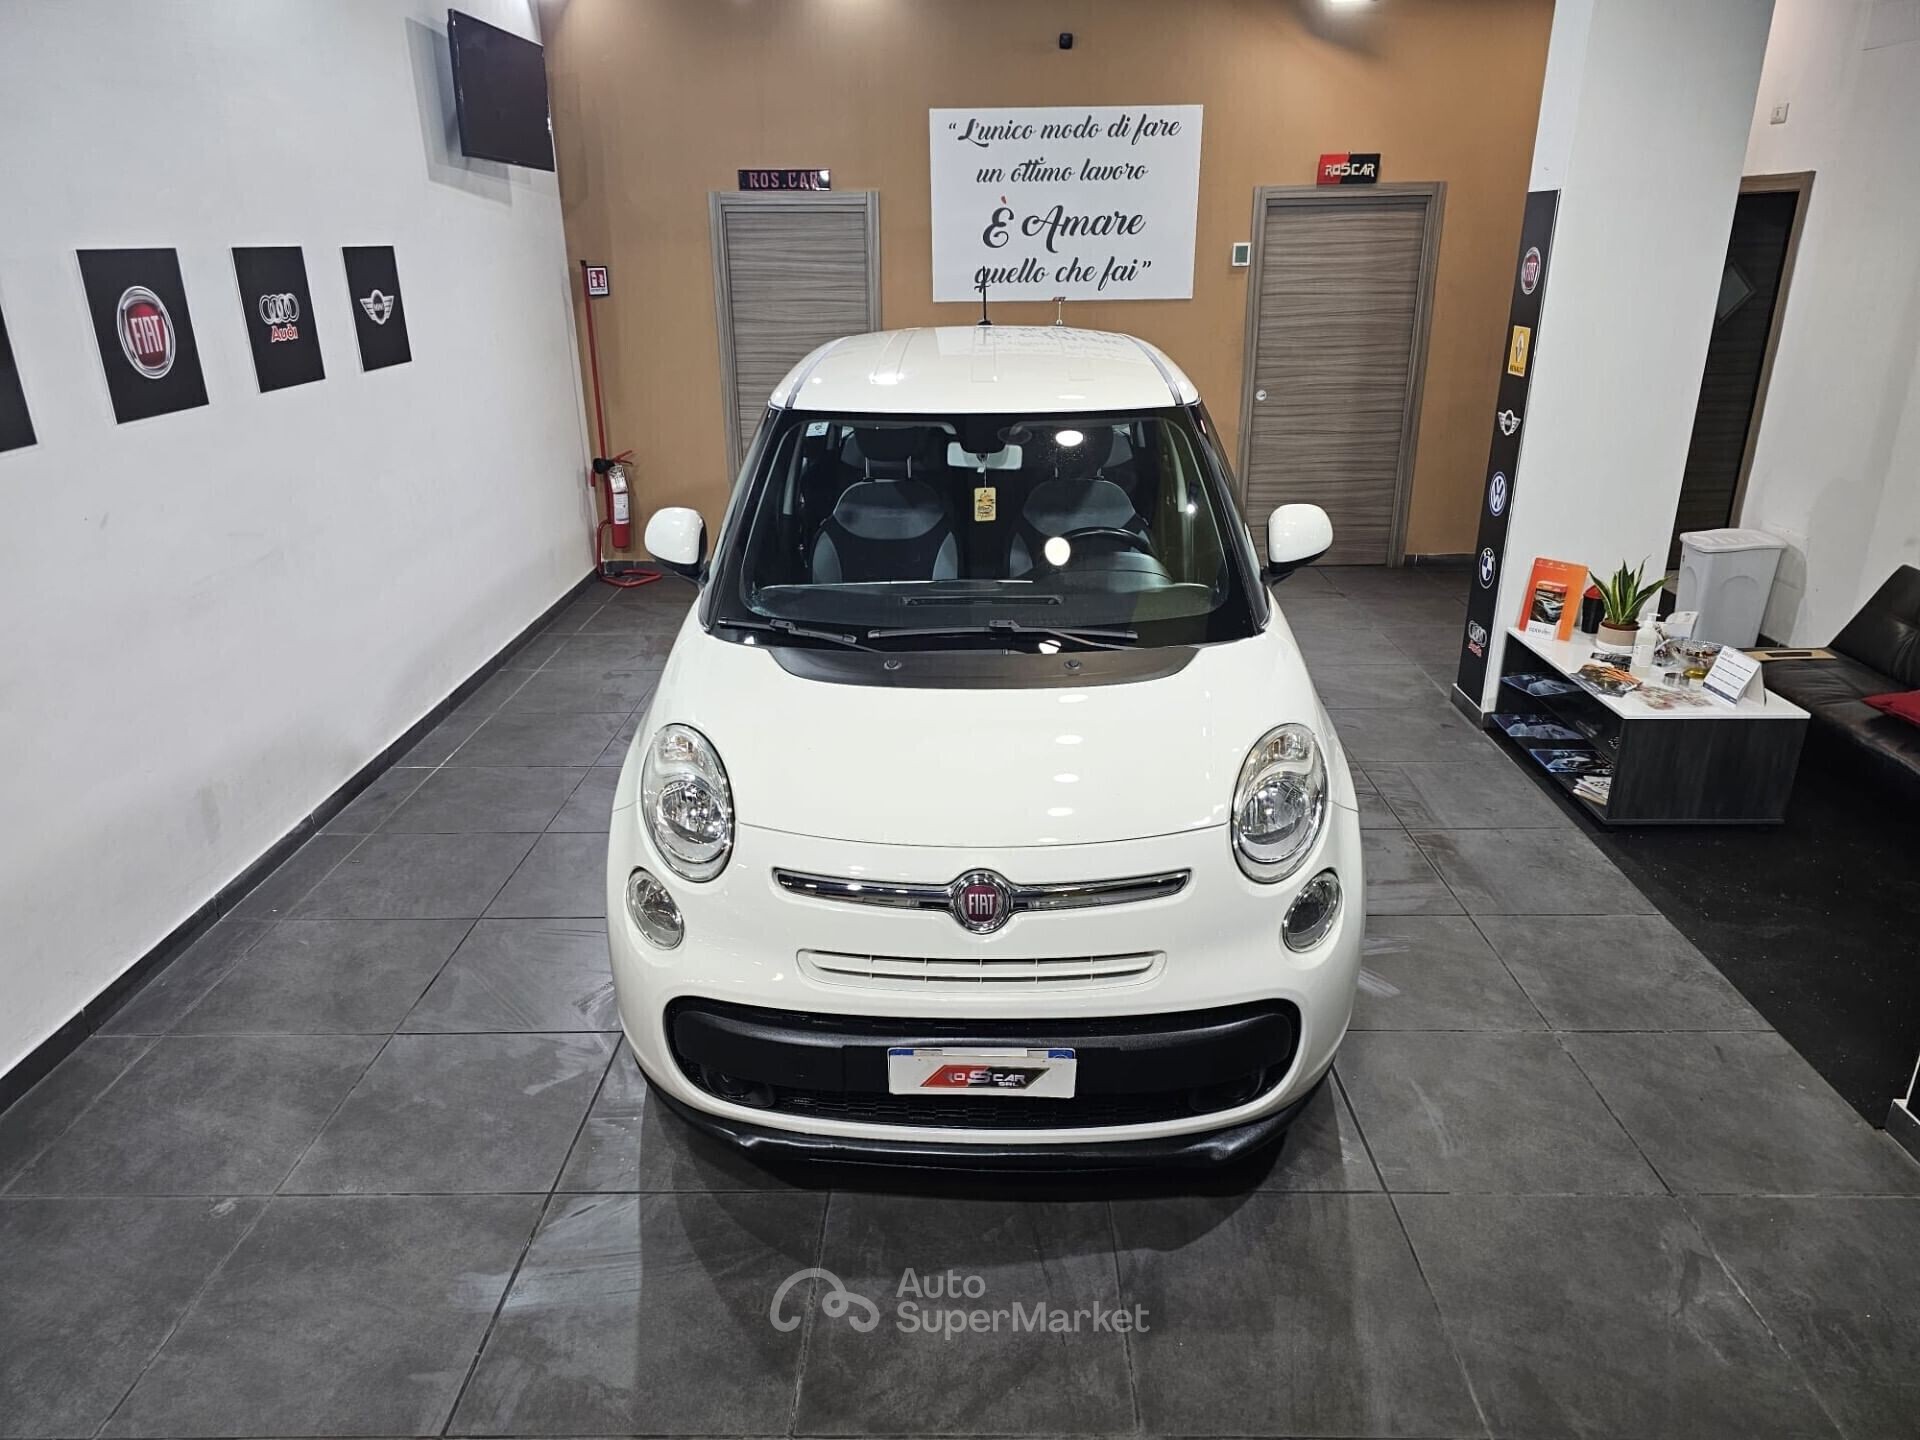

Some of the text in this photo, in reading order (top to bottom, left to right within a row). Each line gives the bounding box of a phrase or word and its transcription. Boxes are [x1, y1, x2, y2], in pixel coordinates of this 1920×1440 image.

[1040, 115, 1102, 140] modo
[1107, 114, 1131, 138] di
[1131, 113, 1182, 146] fare
[749, 171, 819, 190] ROS.CAR
[976, 156, 1149, 184] un ottimo lavoro
[1325, 162, 1375, 177] ROSCAR
[982, 195, 1146, 254] È Amare
[974, 257, 1049, 294] quello
[1055, 257, 1098, 283] che
[130, 314, 164, 356] FIAT
[271, 323, 299, 343] Audi
[968, 893, 996, 915] FIAT
